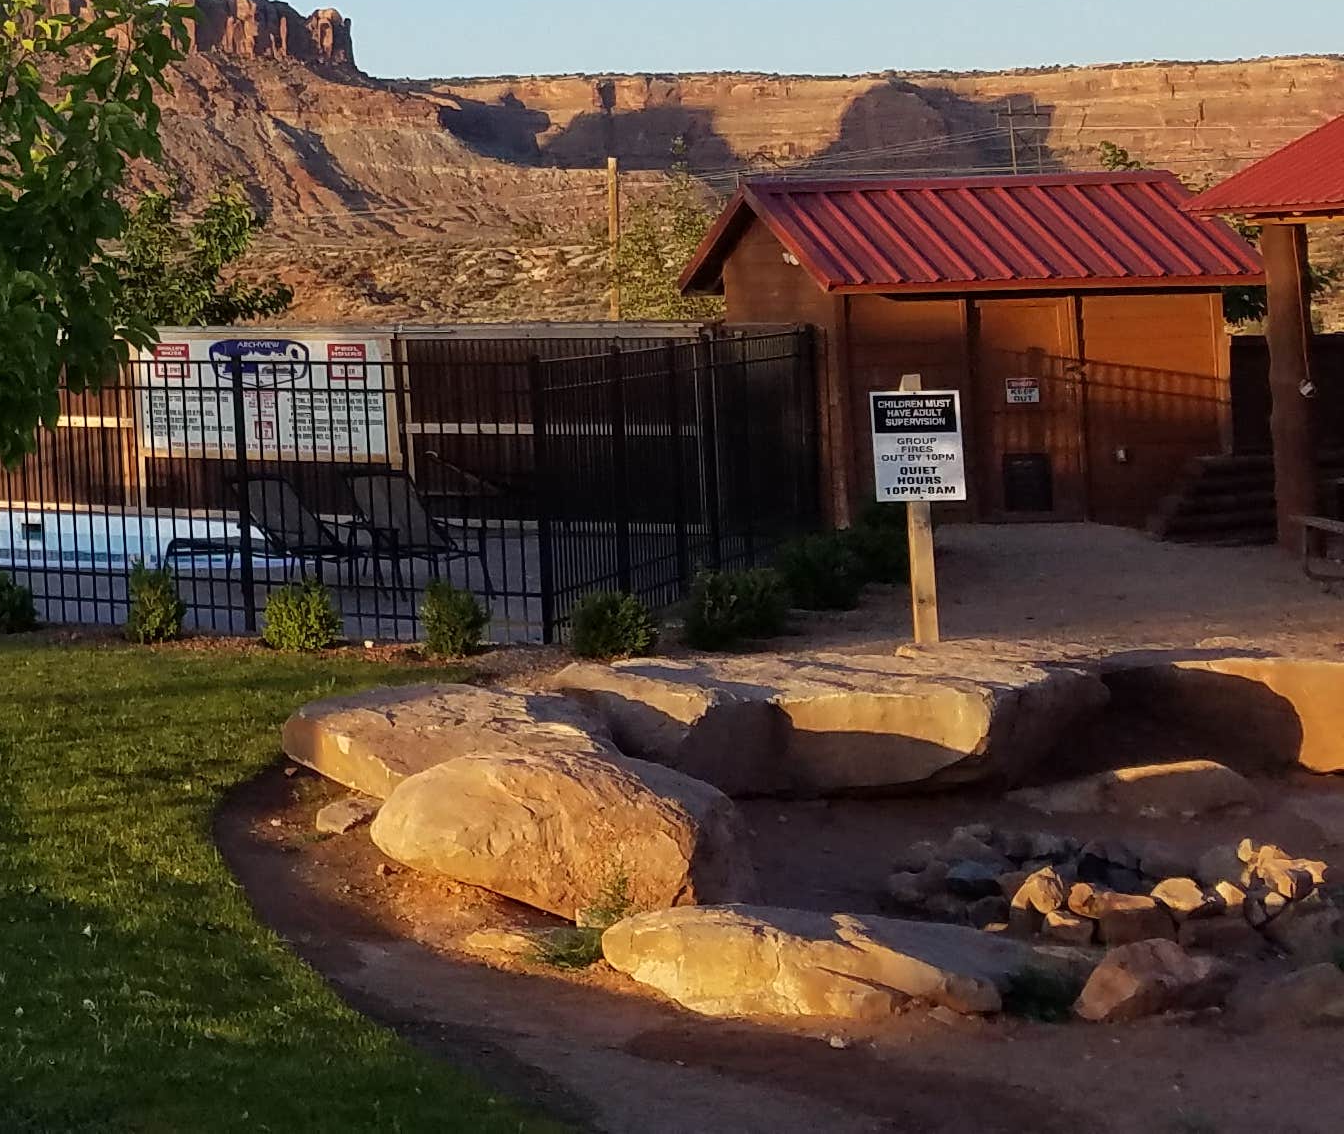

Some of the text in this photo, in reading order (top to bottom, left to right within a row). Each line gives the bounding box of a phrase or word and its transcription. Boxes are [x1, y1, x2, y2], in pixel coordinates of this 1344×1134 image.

[877, 399, 951, 408] CHILDREN MUST
[887, 408, 943, 417] HAVE ADULT
[885, 417, 946, 426] SUPERVISION
[897, 437, 937, 445] GROUP
[926, 453, 955, 461] 10PM
[900, 466, 938, 475] QUIET
[897, 476, 942, 484] HOURS
